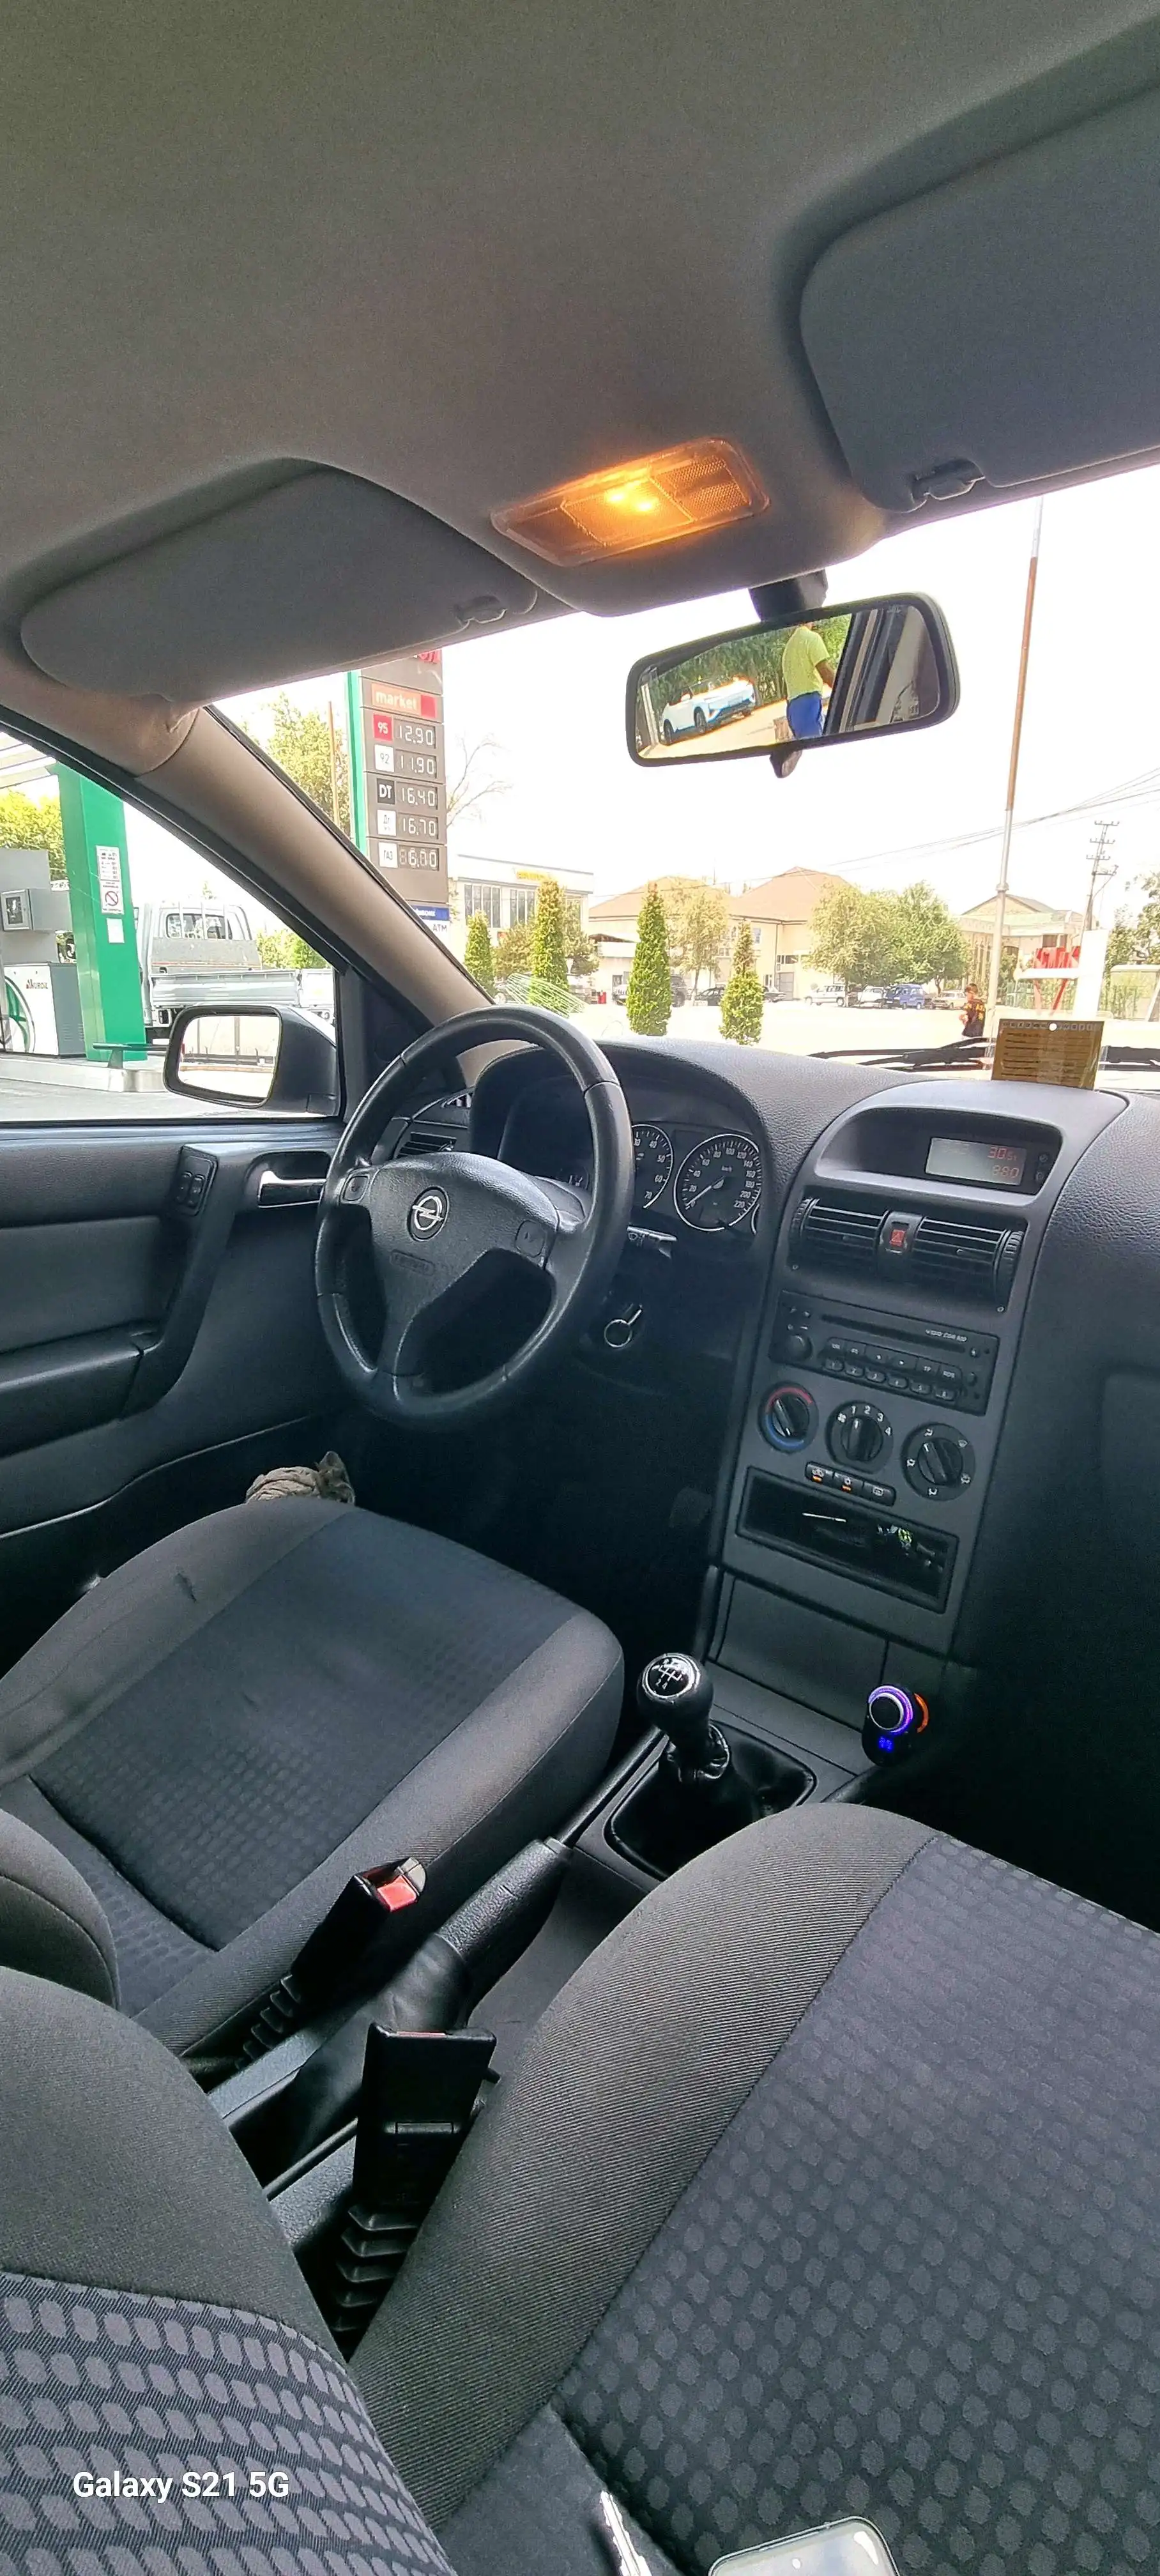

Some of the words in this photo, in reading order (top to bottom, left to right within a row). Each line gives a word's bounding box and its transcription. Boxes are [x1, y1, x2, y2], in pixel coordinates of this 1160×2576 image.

[376, 692, 417, 711] market
[378, 721, 389, 735] 95
[399, 725, 433, 746] 12.90
[380, 753, 390, 765] 92
[401, 755, 434, 774] 11.90
[402, 787, 435, 806] 16.40
[403, 818, 436, 836] 16.70
[851, 1406, 857, 1414] 1
[864, 1406, 871, 1414] 2
[876, 1413, 884, 1422] 3
[885, 1426, 892, 1436] 4
